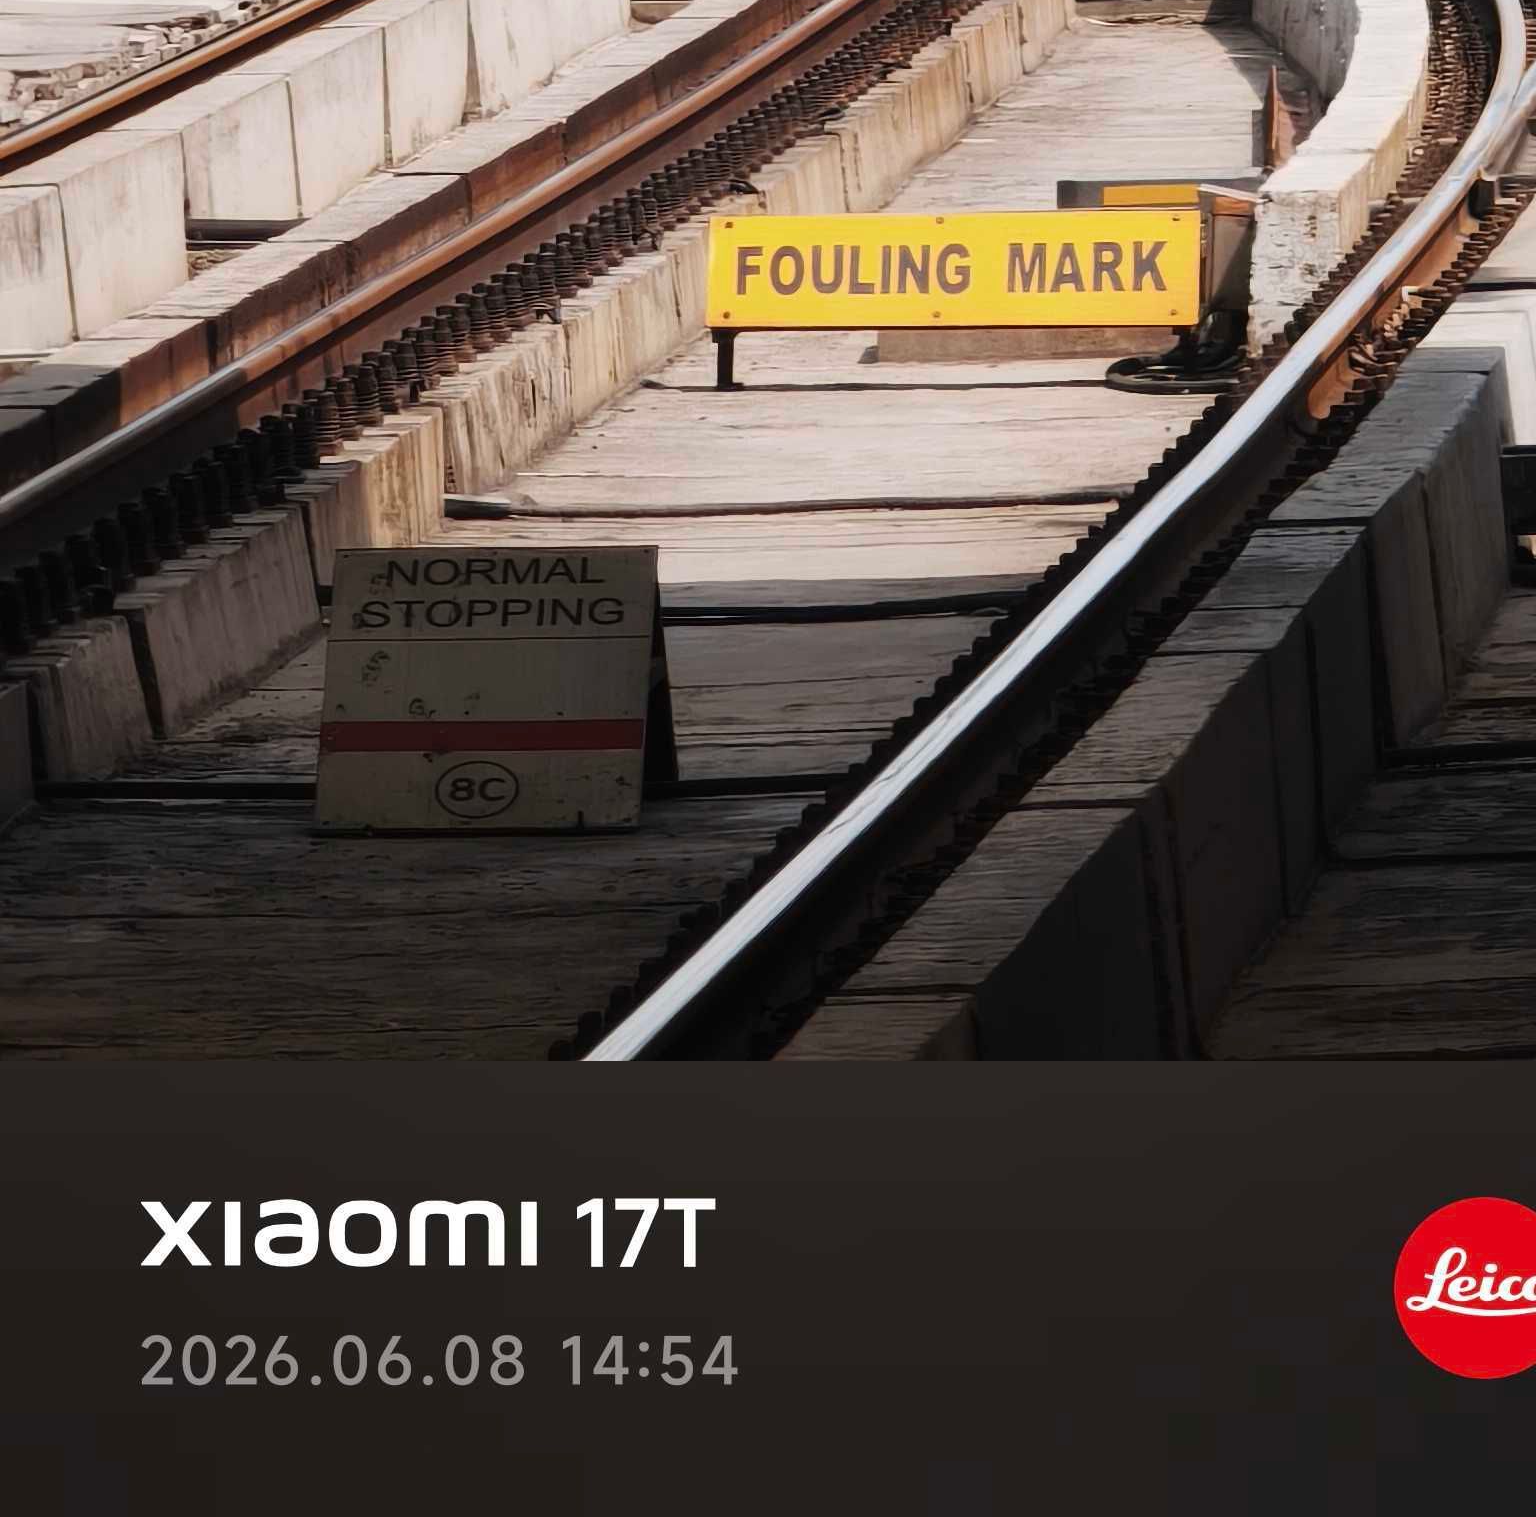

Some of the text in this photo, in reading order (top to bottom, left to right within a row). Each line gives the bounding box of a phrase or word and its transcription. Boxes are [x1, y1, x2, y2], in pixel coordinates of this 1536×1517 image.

[736, 240, 1169, 296] FOULING MARK
[384, 557, 606, 587] NORMAL
[359, 597, 626, 629] STOPPING
[449, 776, 506, 803] 8C
